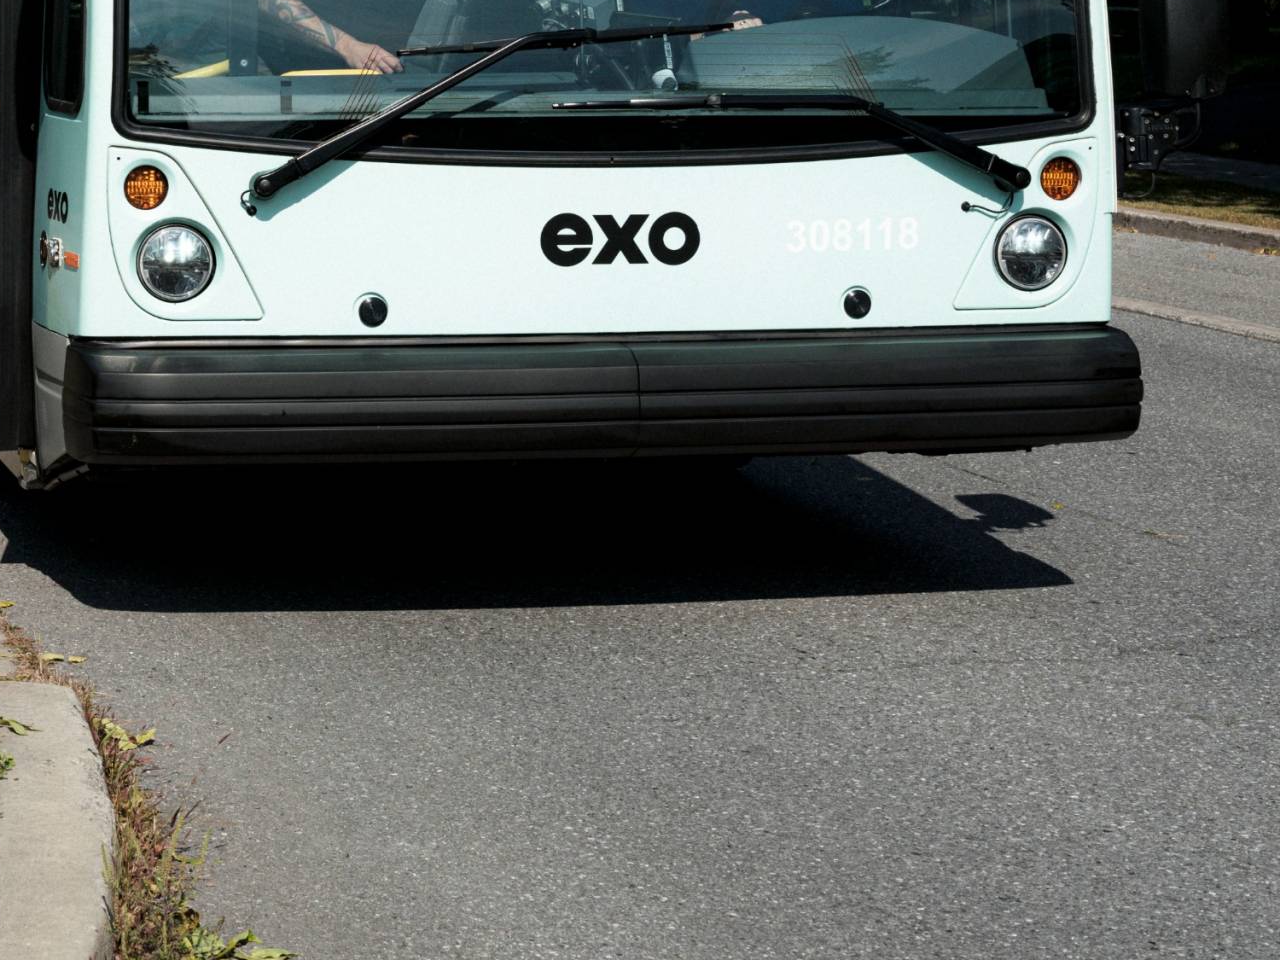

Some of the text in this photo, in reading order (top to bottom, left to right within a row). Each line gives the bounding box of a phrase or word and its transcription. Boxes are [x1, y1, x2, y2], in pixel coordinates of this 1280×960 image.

[47, 188, 69, 224] exo
[540, 211, 701, 267] exo
[786, 216, 920, 253] 308118
